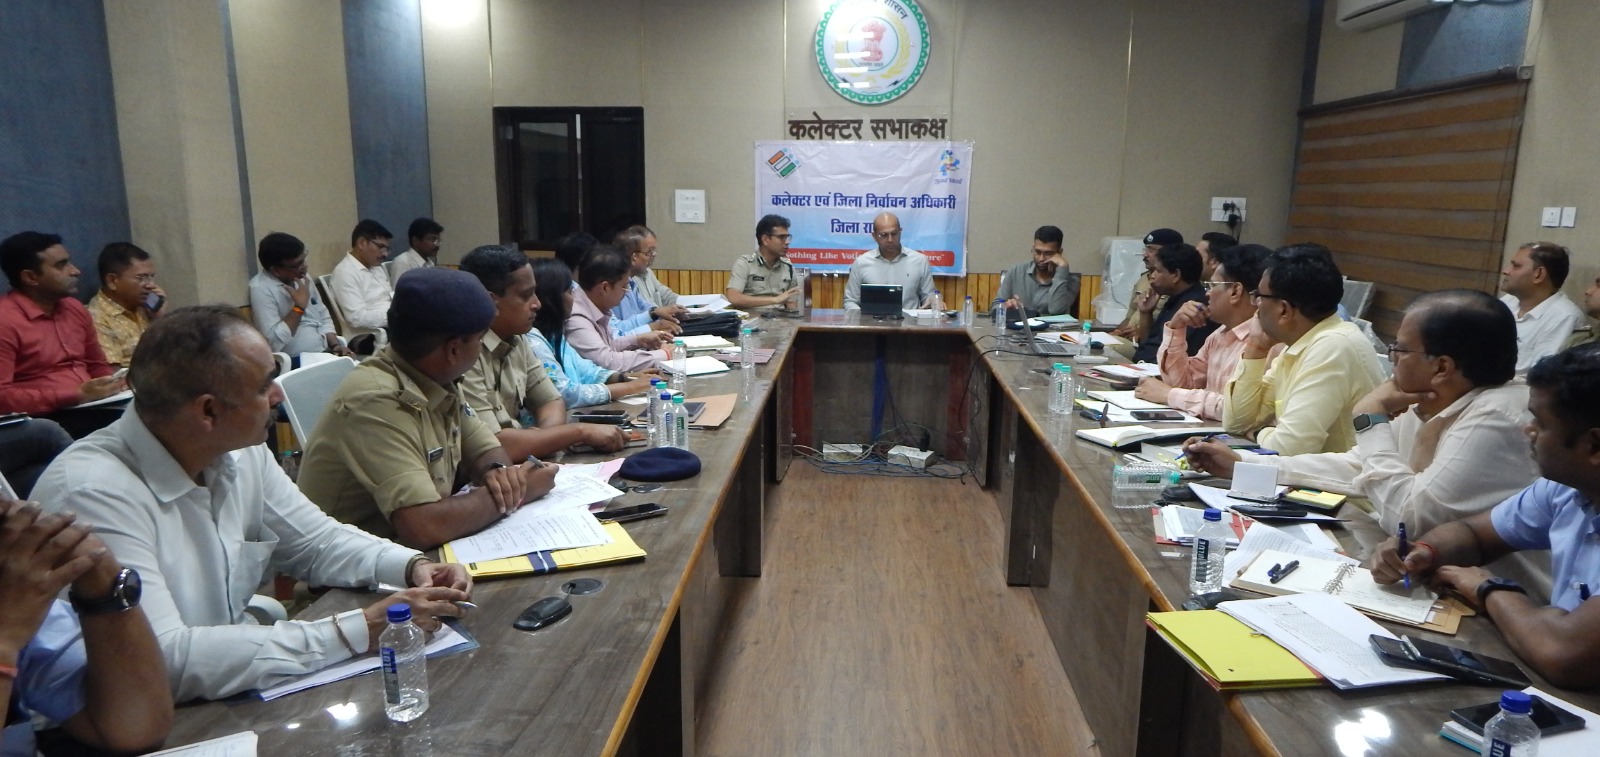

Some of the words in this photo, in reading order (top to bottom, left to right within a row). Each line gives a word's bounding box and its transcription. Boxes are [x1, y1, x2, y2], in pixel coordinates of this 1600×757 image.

[788, 111, 863, 140] कलेक्टर
[870, 118, 948, 140] सभाकक्ष
[771, 191, 812, 206] कलेक्टर
[814, 192, 832, 207] एवं
[834, 192, 863, 208] जिला
[866, 192, 907, 208] निर्वाचन
[910, 194, 956, 209] अधिकारी
[831, 218, 860, 234] जिला
[841, 251, 862, 260] Voti
[1198, 540, 1207, 559] BLUE
[382, 650, 393, 673] BLUE
[1492, 742, 1505, 757] UE
